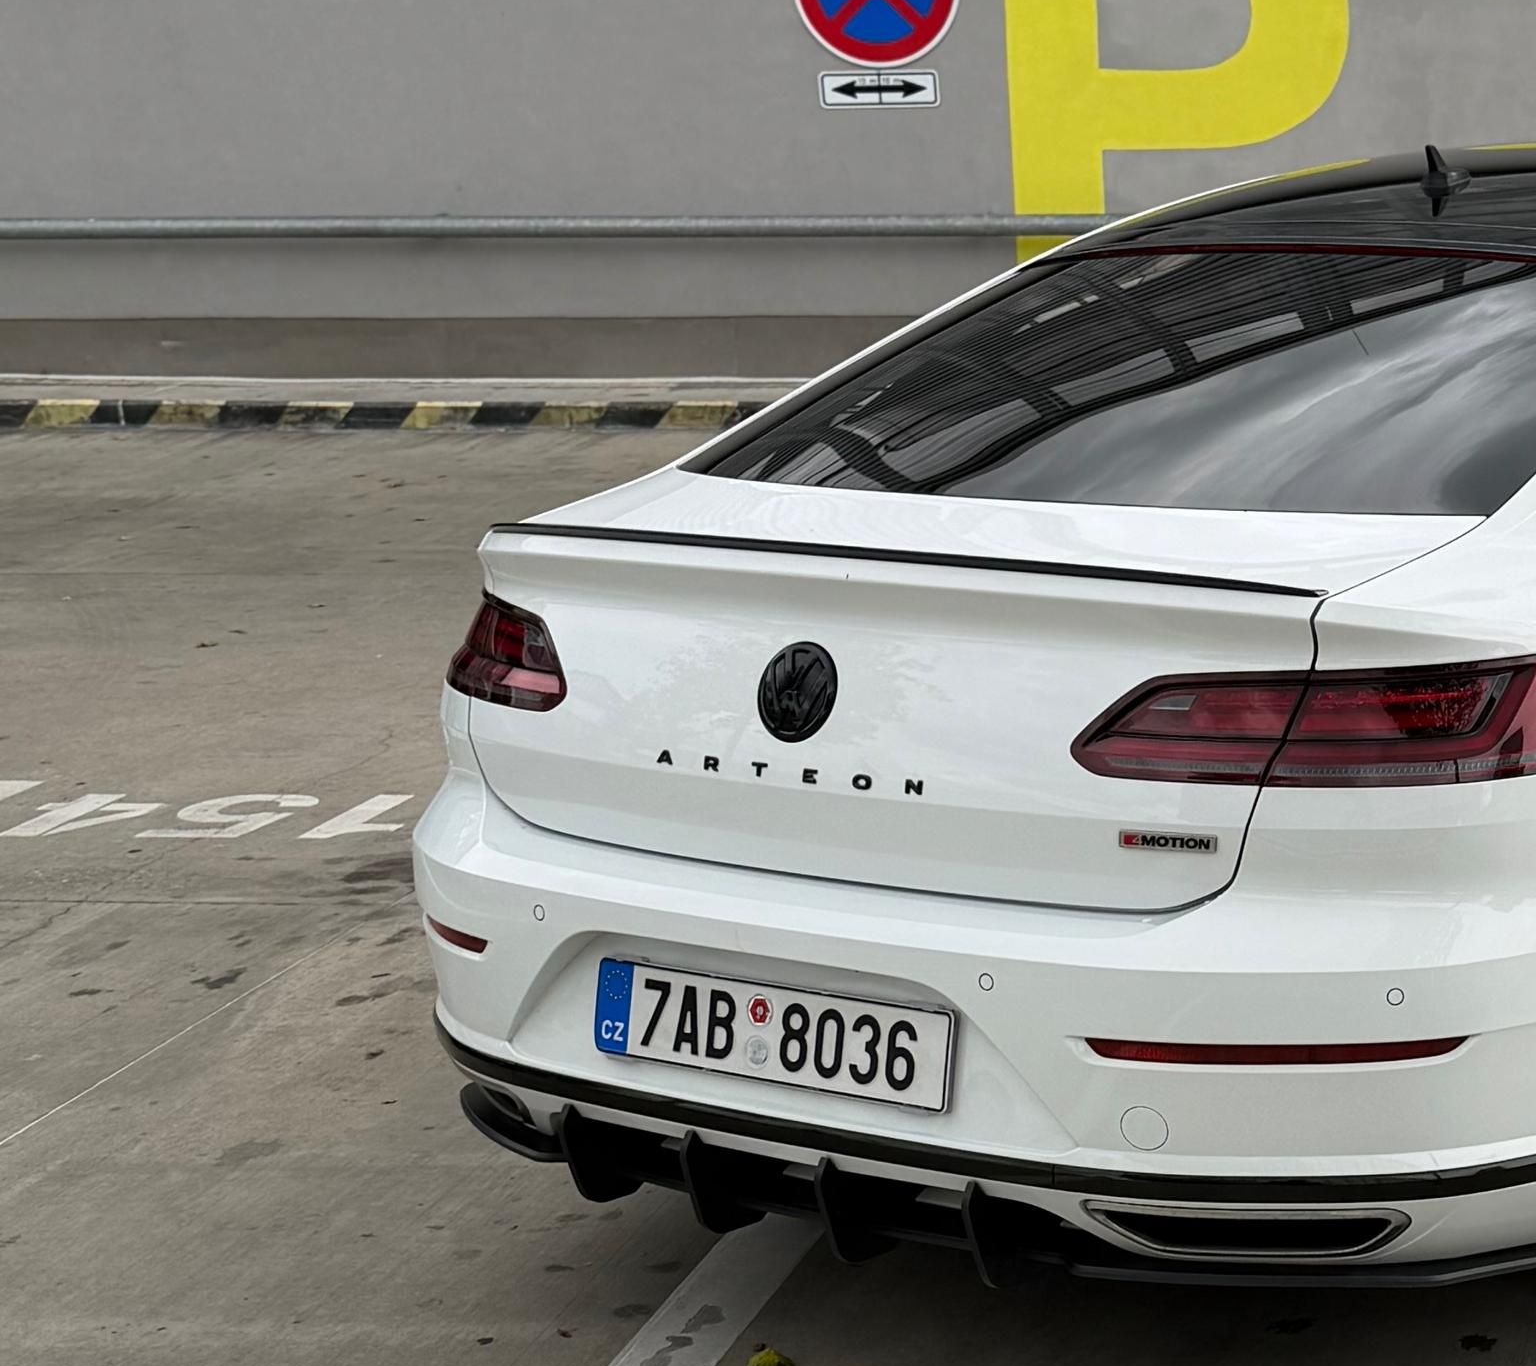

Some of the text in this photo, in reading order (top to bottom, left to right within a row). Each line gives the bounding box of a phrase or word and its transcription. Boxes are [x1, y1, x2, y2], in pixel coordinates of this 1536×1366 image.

[656, 749, 924, 796] ARTEON
[0, 793, 414, 839] 154
[1130, 834, 1211, 850] 4MOTION
[601, 1020, 624, 1042] CZ
[639, 978, 918, 1091] 7AB 8036
